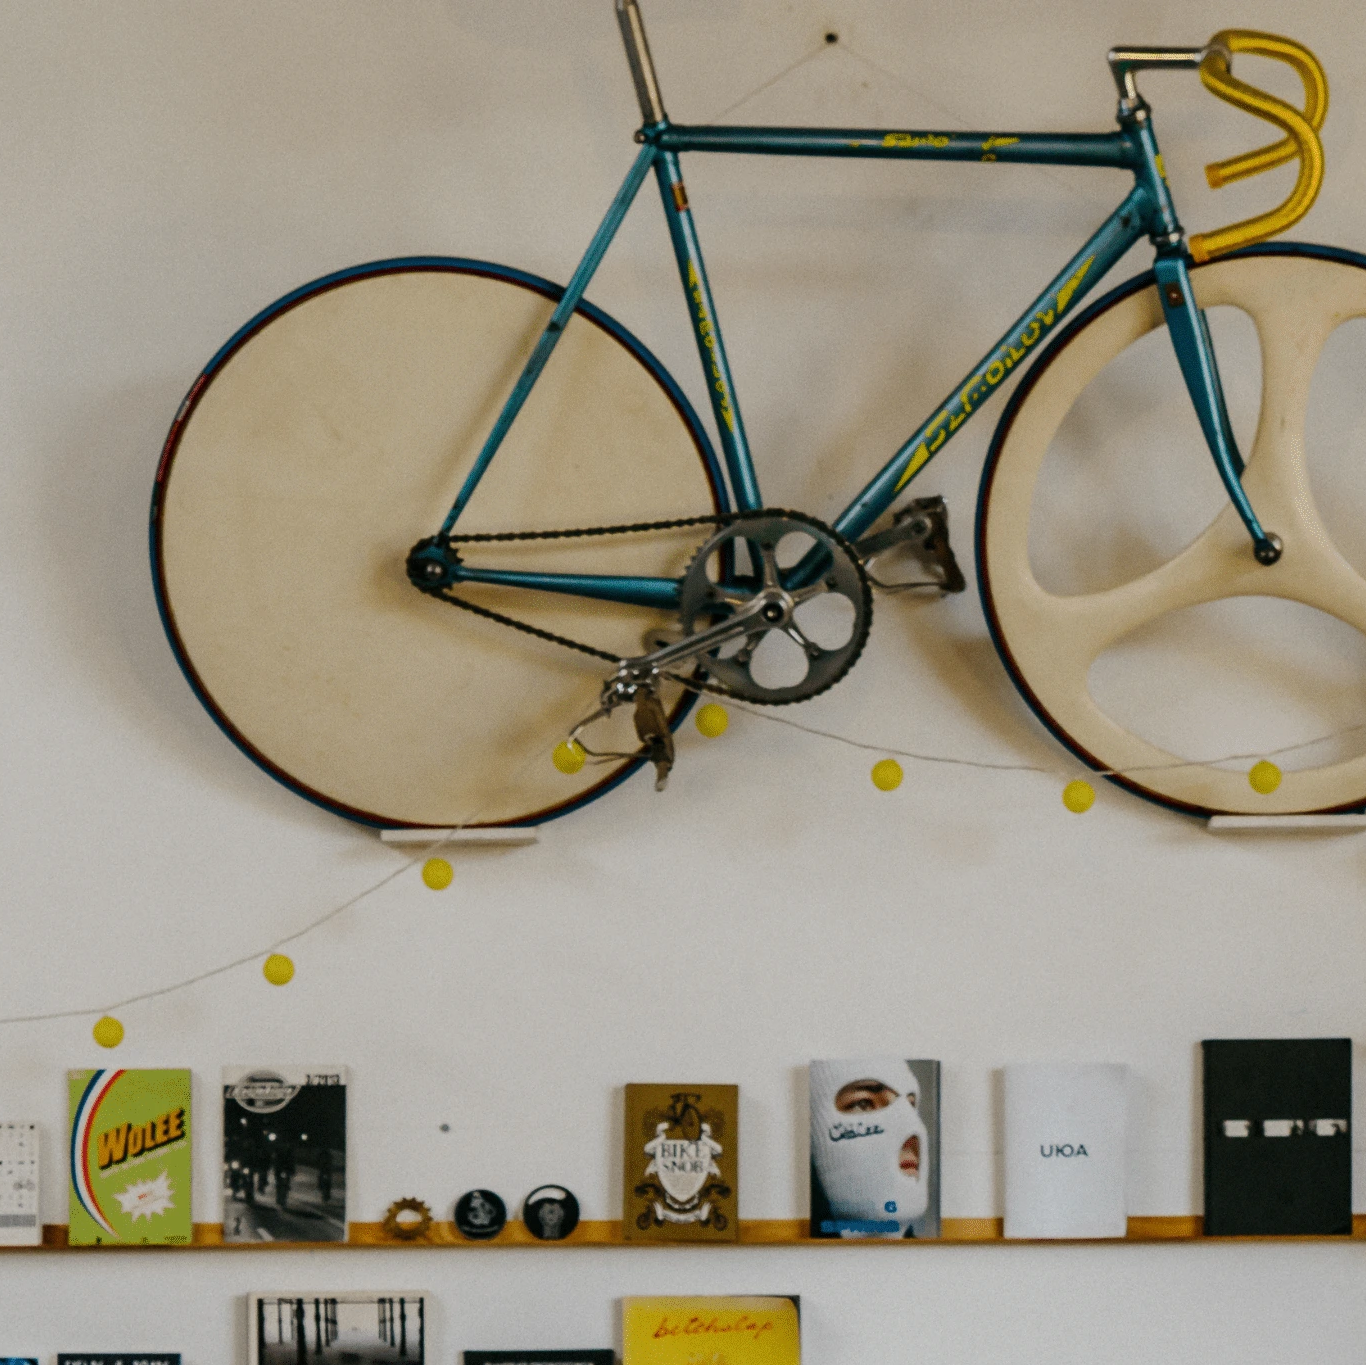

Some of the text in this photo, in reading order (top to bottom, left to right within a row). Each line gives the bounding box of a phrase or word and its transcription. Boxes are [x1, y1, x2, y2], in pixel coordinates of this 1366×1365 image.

[97, 1108, 186, 1170] WOLEE
[660, 1140, 709, 1160] BIKE
[662, 1159, 705, 1175] SNOB
